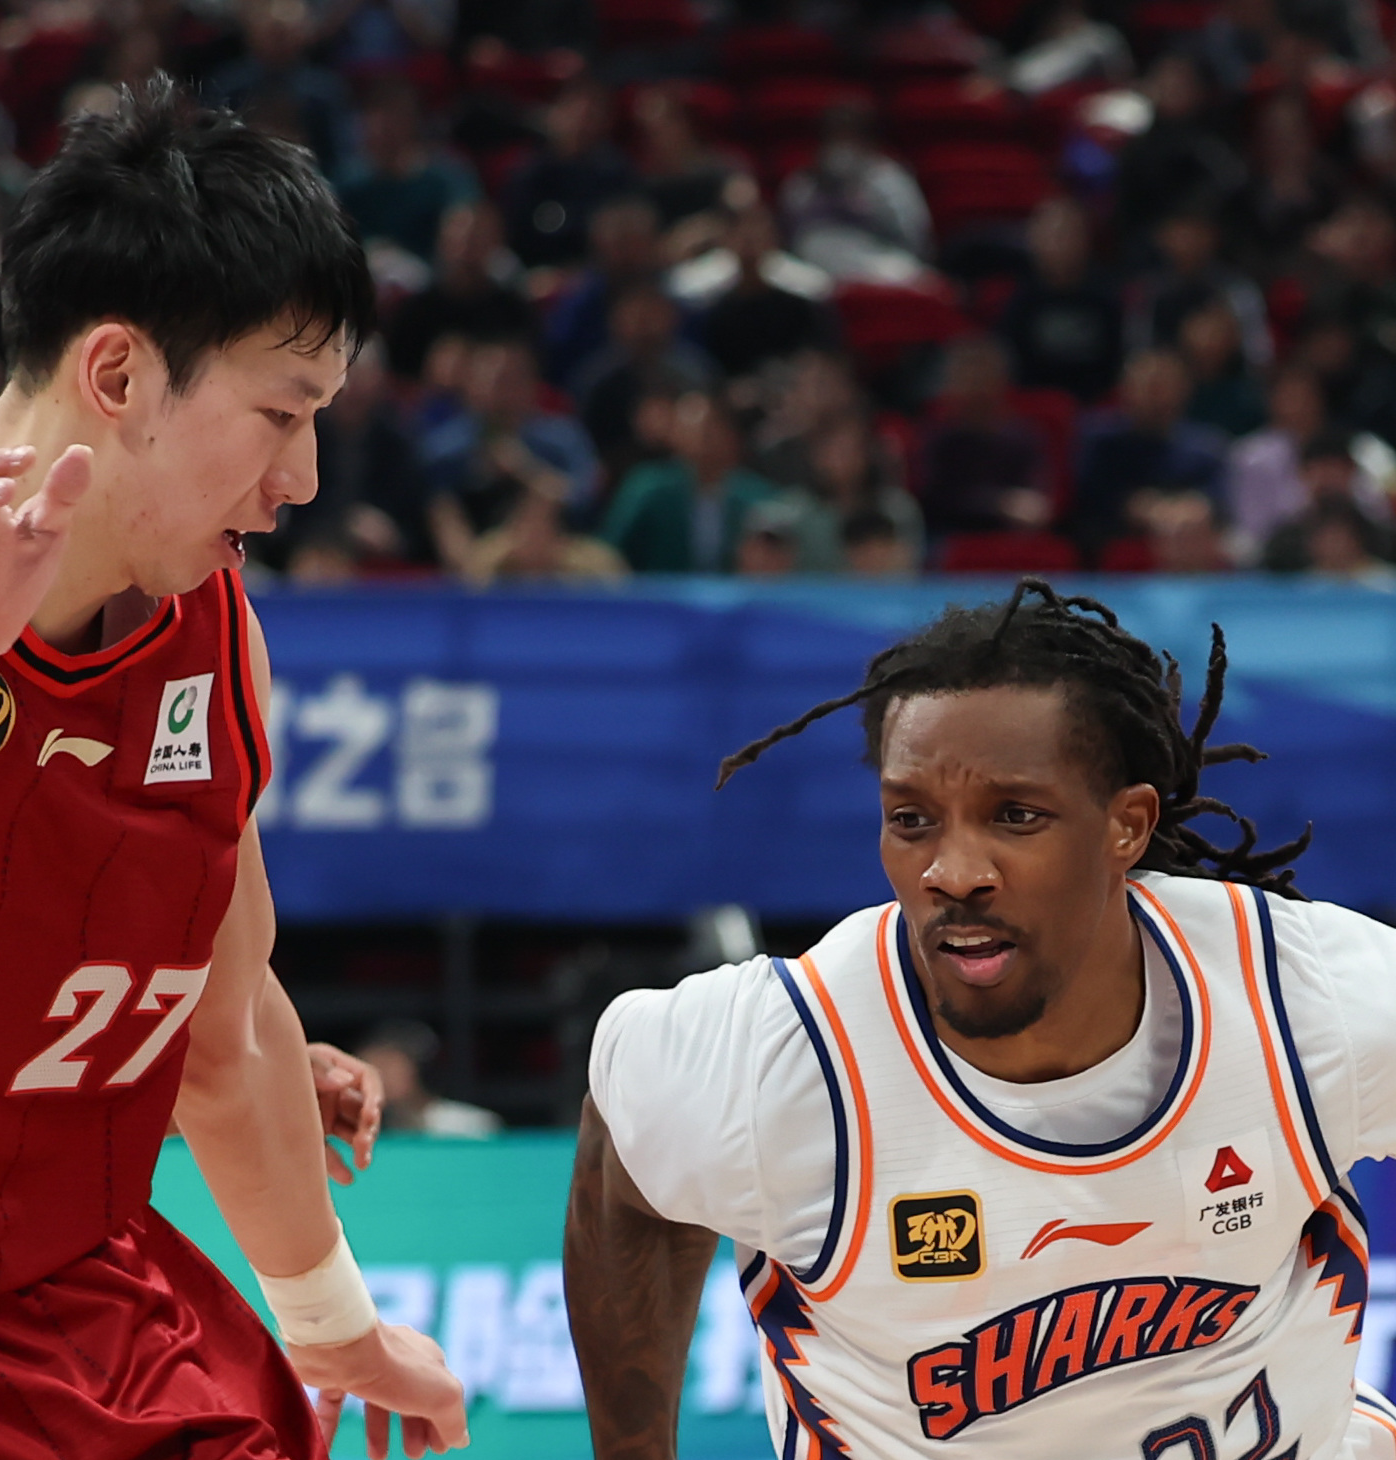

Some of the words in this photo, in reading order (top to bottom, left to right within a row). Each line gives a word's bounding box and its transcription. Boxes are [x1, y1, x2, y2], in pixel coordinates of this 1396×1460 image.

[153, 742, 202, 762] 中国人寿
[256, 675, 499, 828] 之名
[179, 760, 203, 771] LIFE
[6, 961, 212, 1097] 27
[1199, 1191, 1264, 1222] 广发银行
[1212, 1213, 1252, 1235] CGB
[918, 1250, 968, 1265] CBA
[908, 1277, 1260, 1440] SHARKS
